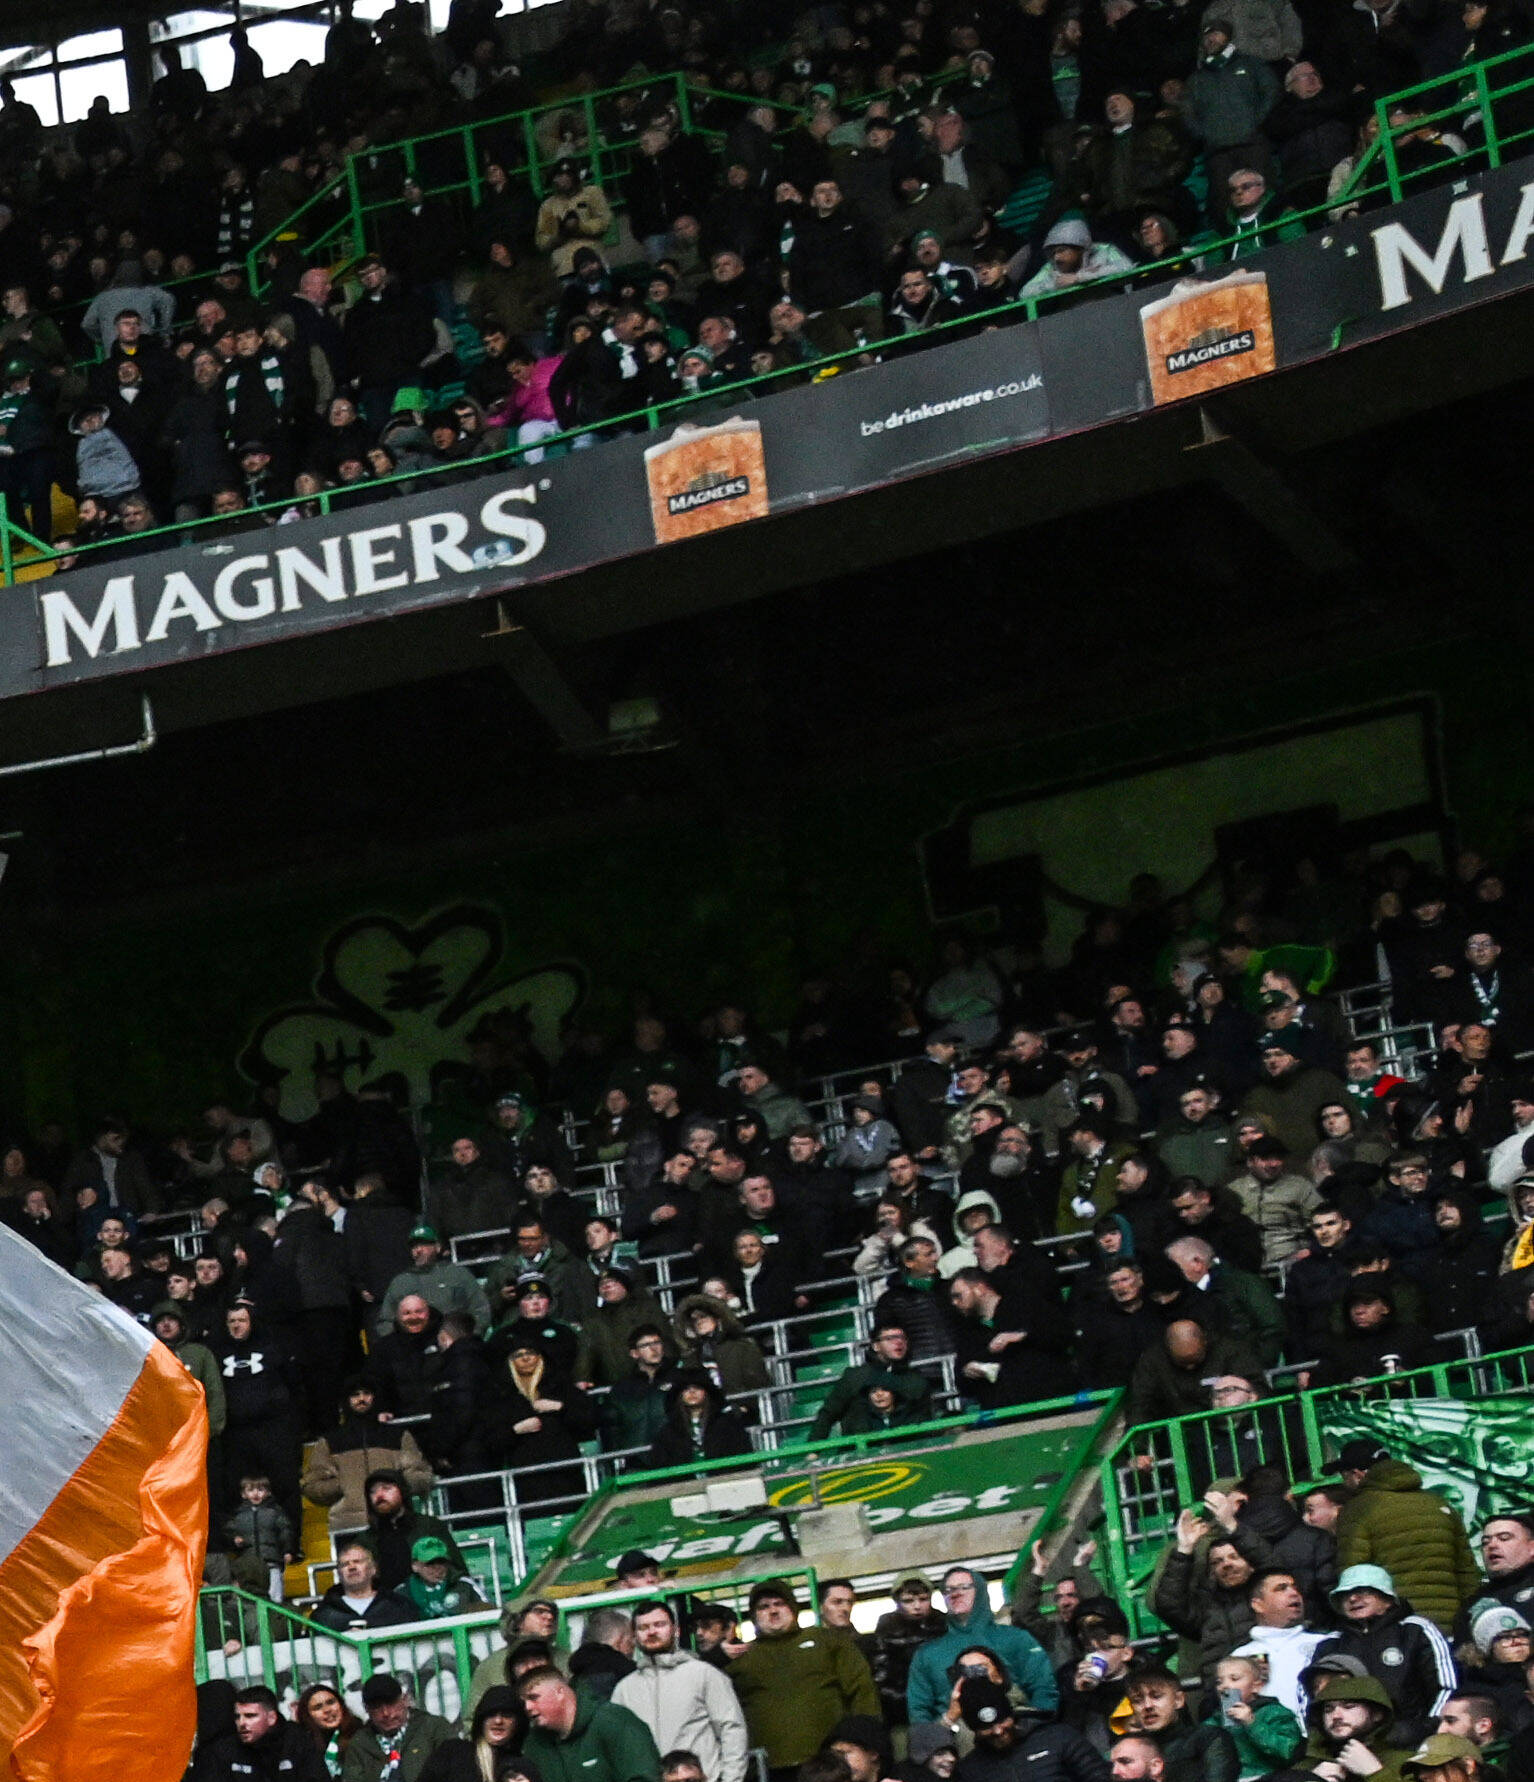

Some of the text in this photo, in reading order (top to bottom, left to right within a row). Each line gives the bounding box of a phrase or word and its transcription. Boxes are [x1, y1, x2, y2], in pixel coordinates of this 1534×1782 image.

[1168, 335, 1251, 371] MAGNERS
[860, 373, 1043, 438] bedrinkaware.co.uk
[669, 481, 747, 512] MAGNERS
[42, 483, 549, 667] MAGNERS
